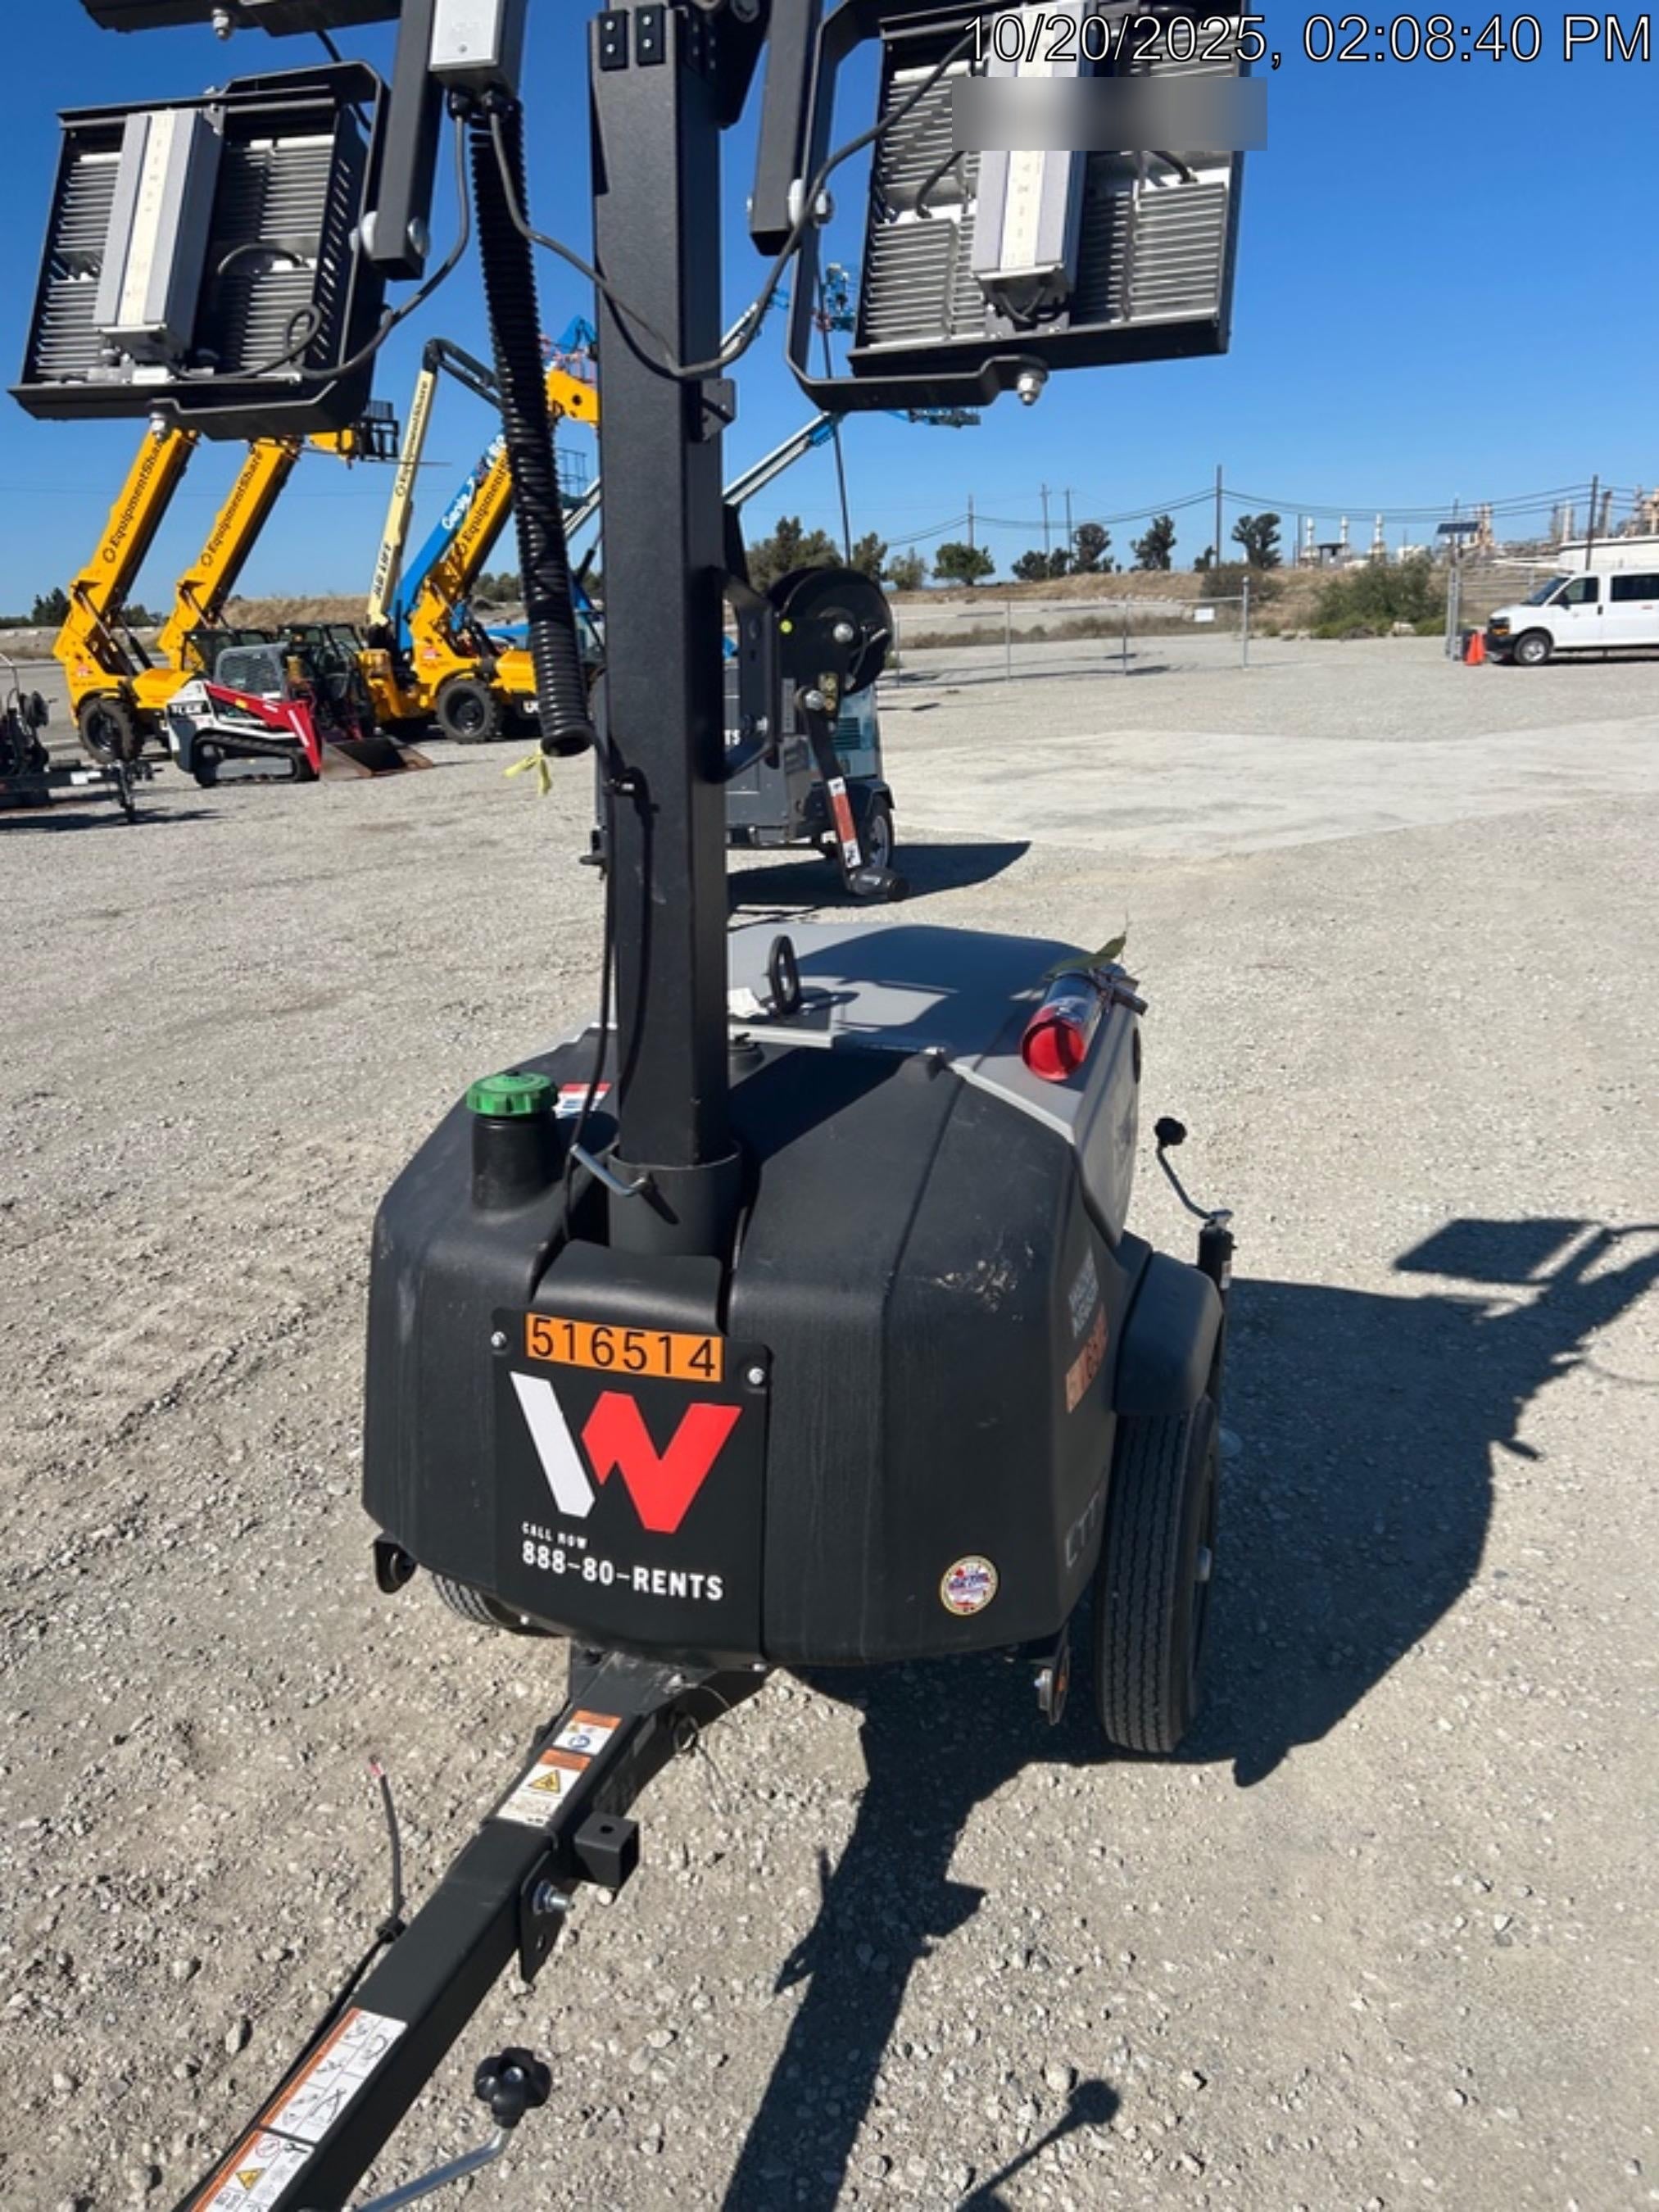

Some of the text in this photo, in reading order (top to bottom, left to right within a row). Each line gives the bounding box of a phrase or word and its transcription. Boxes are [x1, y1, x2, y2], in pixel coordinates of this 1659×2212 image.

[110, 440, 165, 549] EquipmentShar
[532, 1316, 716, 1377] 516514
[522, 1521, 587, 1549] CALL NOW
[522, 1539, 723, 1601] 888-80-RENTS
